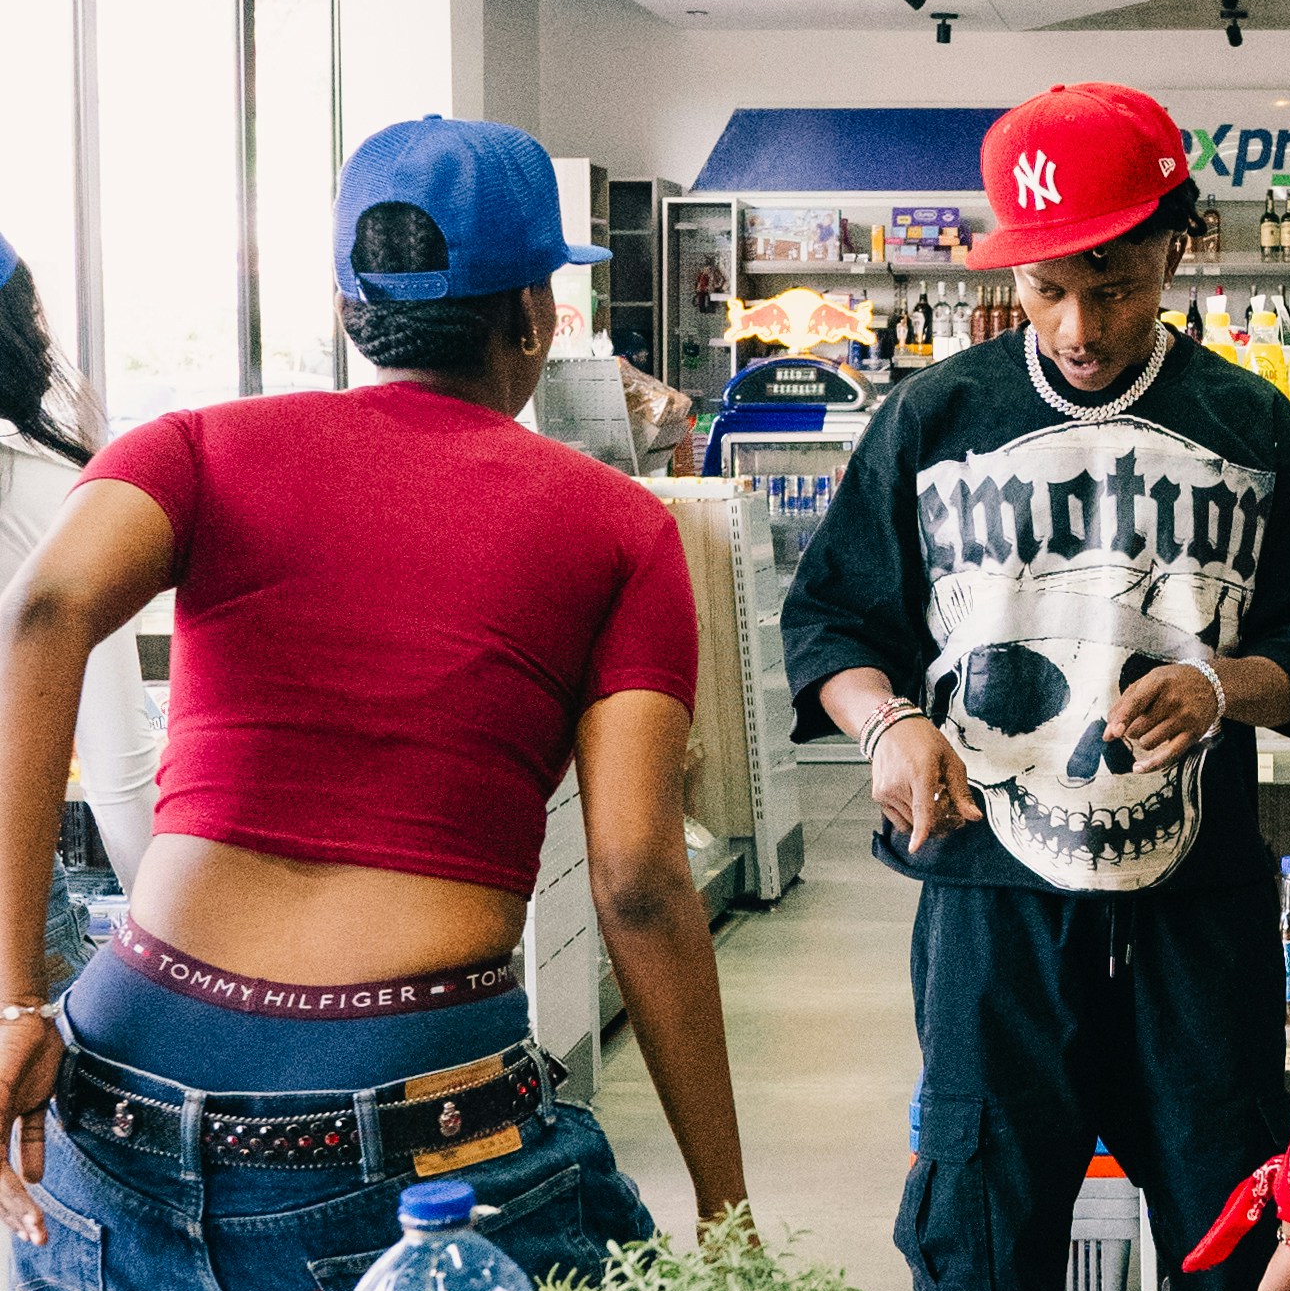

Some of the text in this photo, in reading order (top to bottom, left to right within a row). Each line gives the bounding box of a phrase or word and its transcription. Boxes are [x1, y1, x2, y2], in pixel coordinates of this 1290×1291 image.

[1013, 149, 1062, 211] NY
[917, 447, 1273, 583] emotion
[156, 954, 510, 1010] TOMMY HILFIGER TOM
